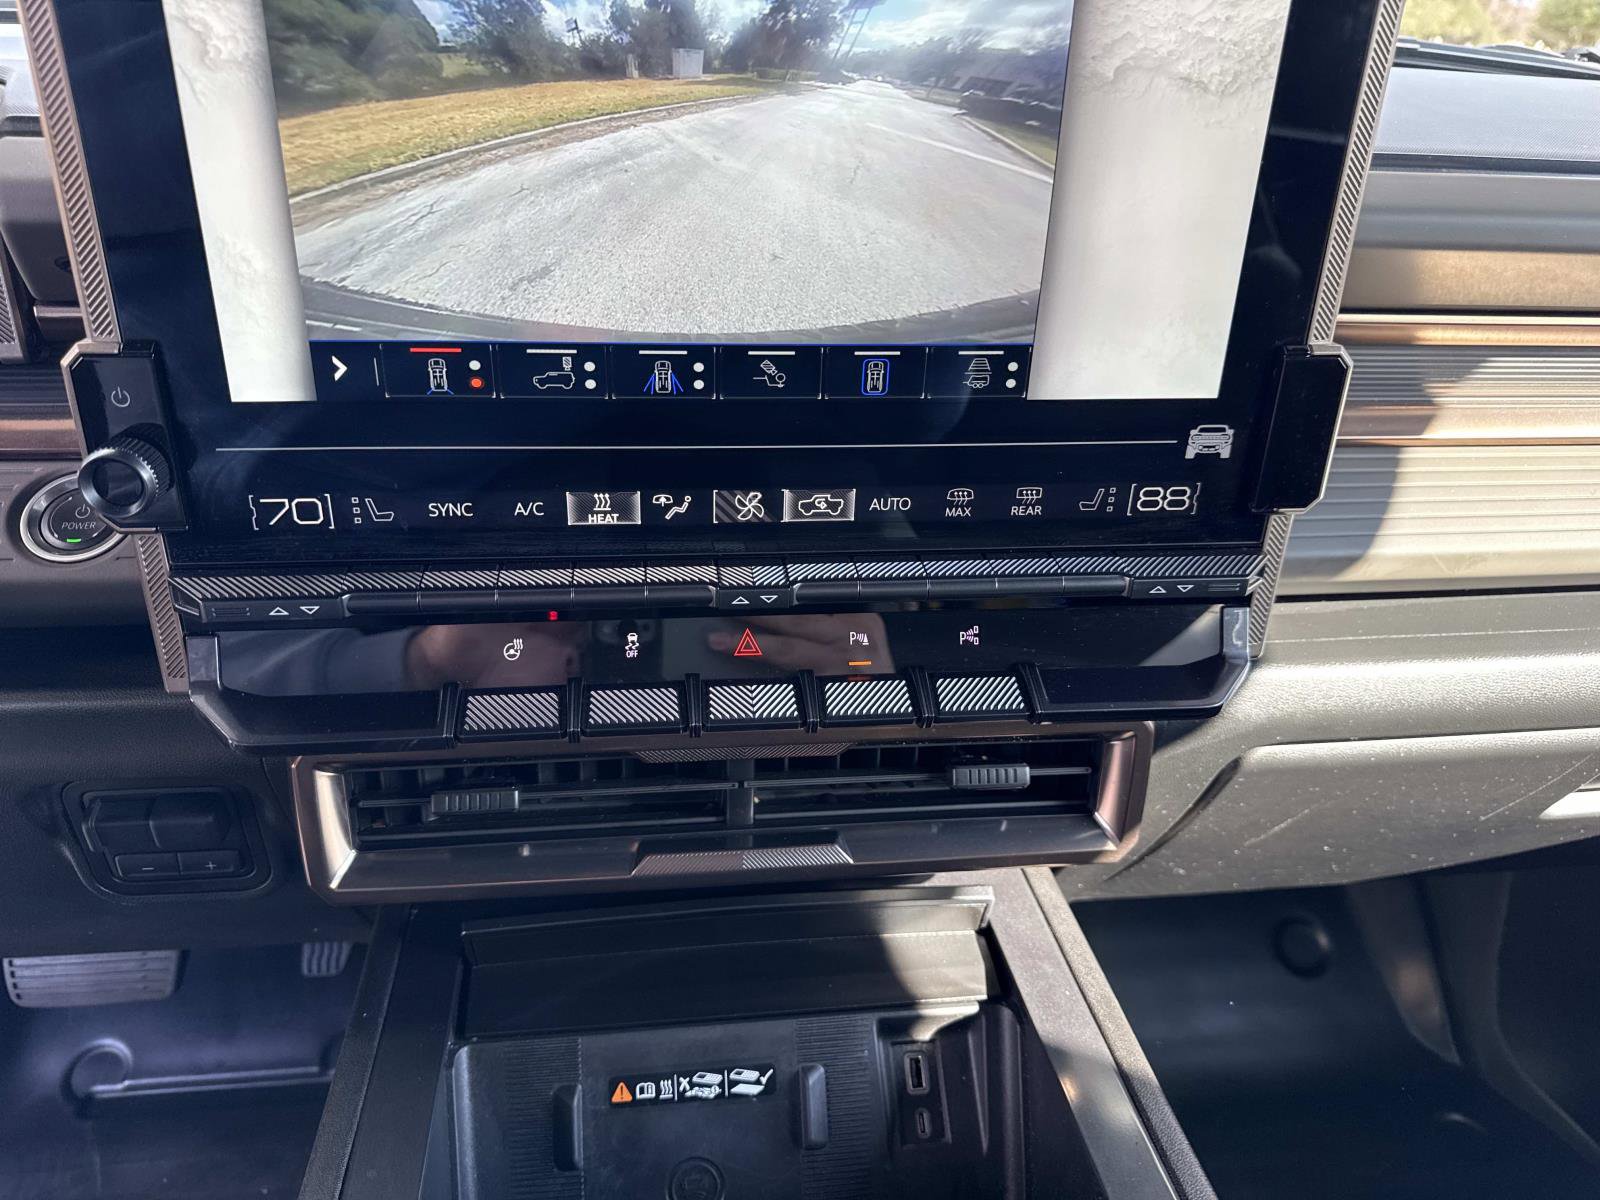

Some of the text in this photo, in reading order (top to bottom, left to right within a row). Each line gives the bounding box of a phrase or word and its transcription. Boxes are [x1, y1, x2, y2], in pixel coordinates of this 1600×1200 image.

[869, 497, 912, 511] AUTO
[1136, 486, 1191, 512] 88
[258, 498, 325, 526] 70
[428, 502, 474, 517] SYNC
[514, 501, 545, 516] A/C
[945, 506, 972, 517] MAX
[1010, 505, 1042, 516] REAR
[588, 513, 619, 524] HEAT
[61, 521, 97, 531] POWER
[625, 650, 639, 659] OFF
